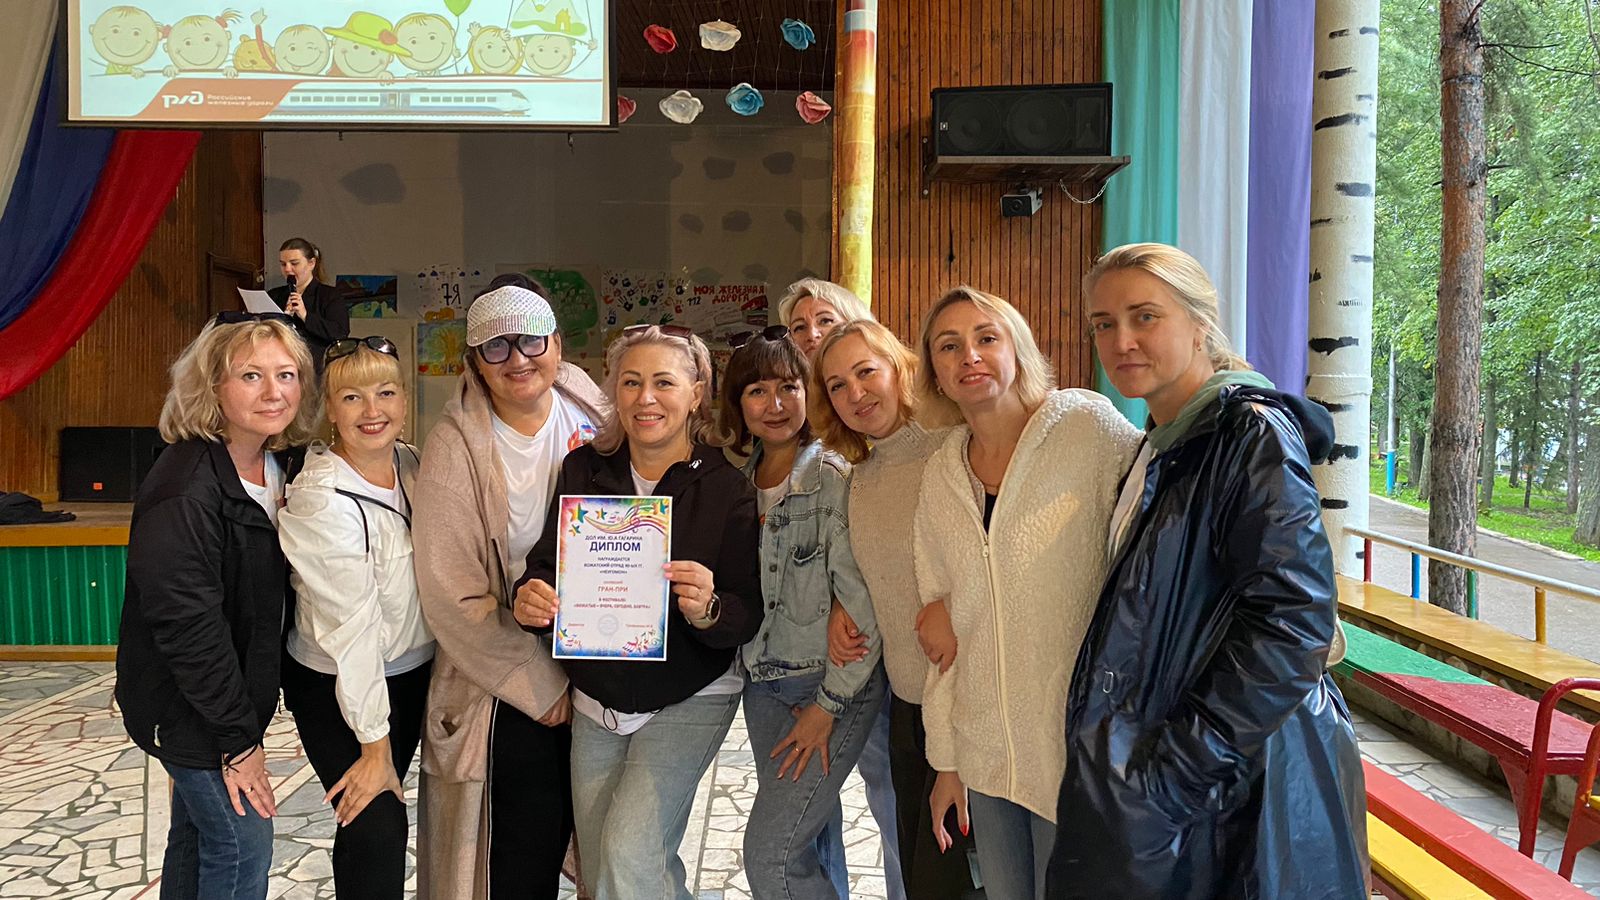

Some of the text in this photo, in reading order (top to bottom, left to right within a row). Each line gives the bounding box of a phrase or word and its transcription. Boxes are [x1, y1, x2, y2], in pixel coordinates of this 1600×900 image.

[693, 285, 765, 295] МОЯ ЖЕЛЕЗНАЯ
[712, 294, 749, 304] ДОРОГА
[589, 541, 641, 552] ДИПЛОМ
